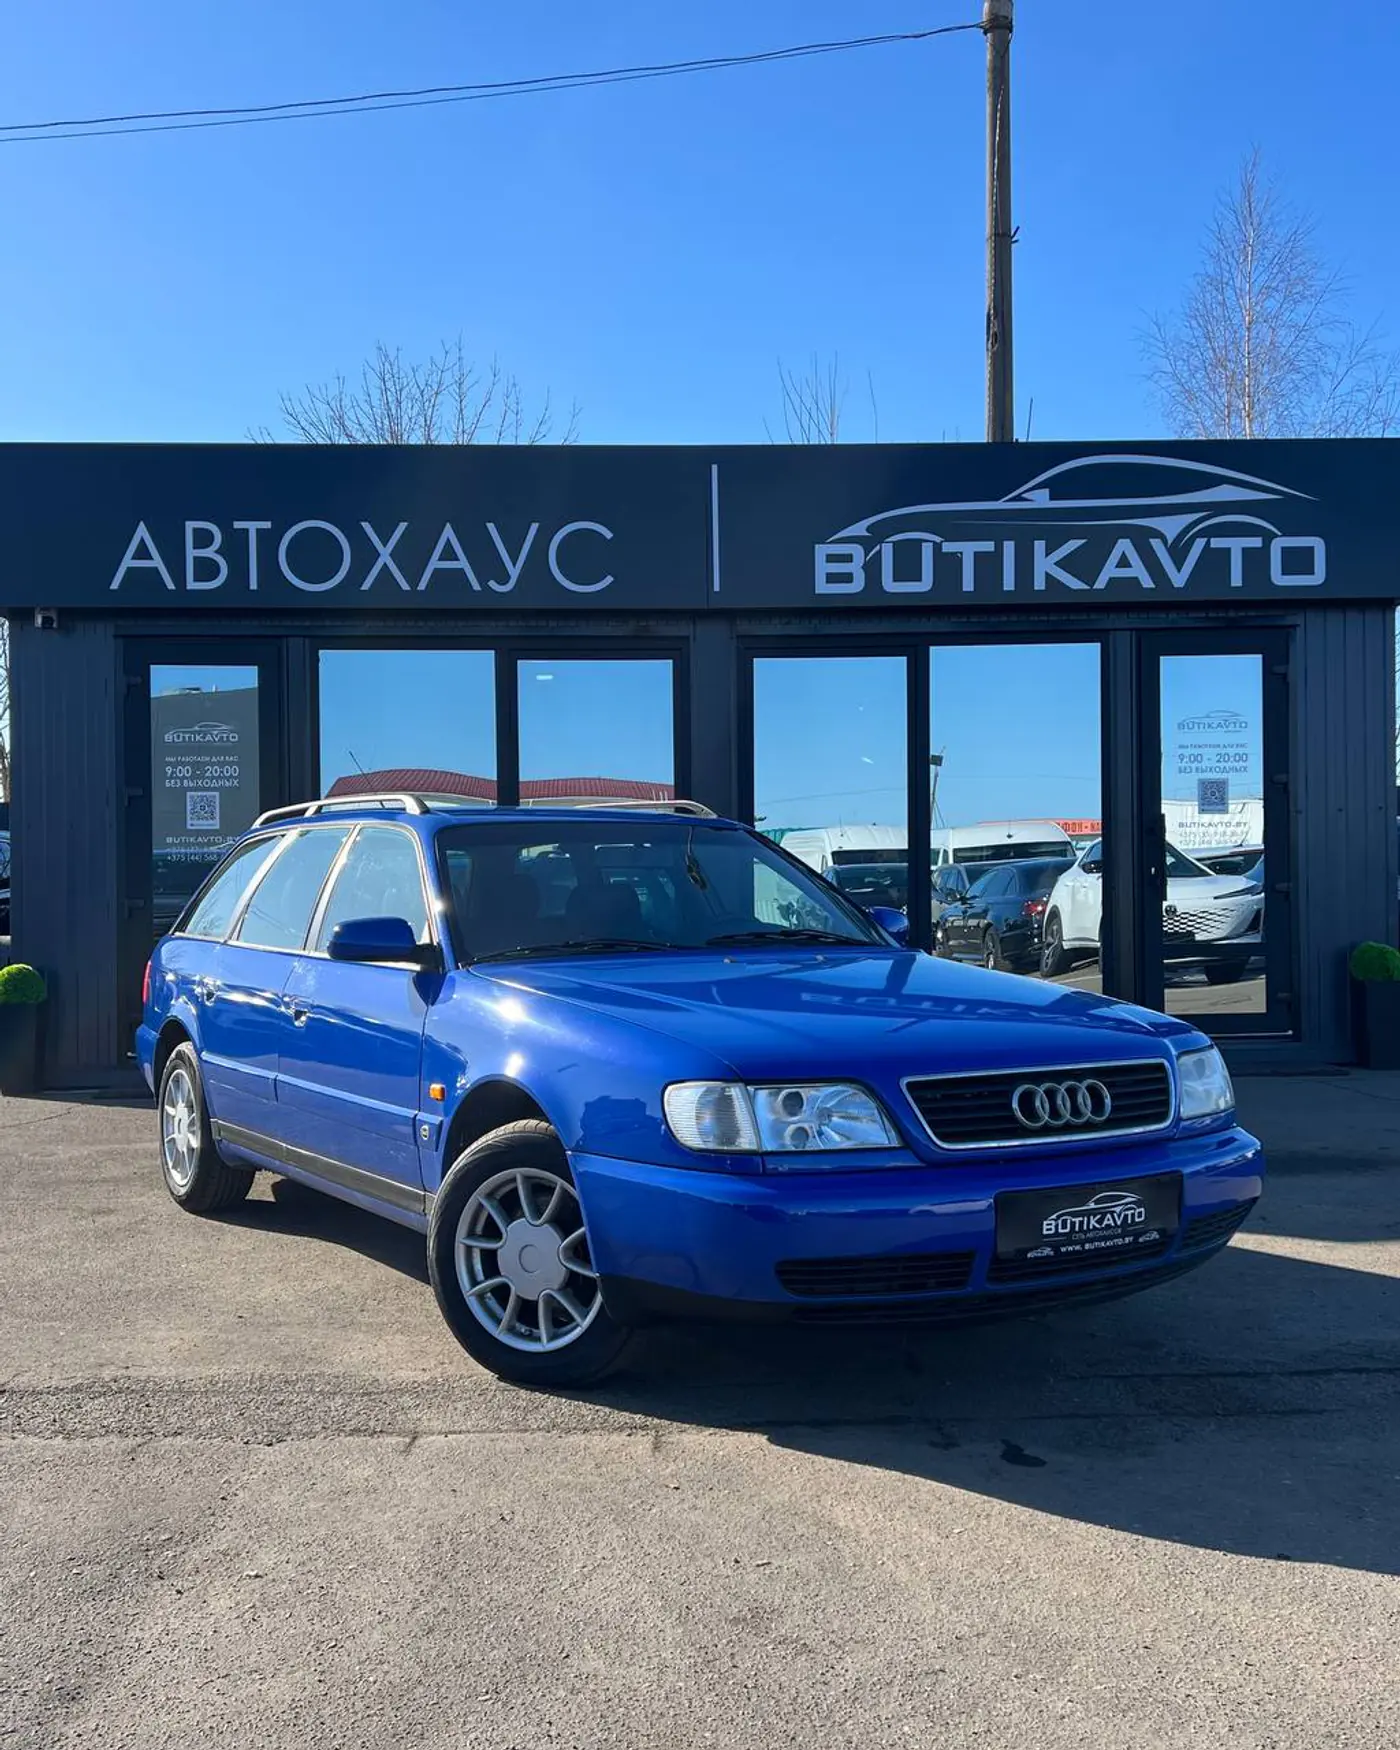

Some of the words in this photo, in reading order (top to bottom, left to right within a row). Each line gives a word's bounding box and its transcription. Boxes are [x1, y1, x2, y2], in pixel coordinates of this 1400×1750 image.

[109, 519, 615, 593] АВТОХАУС
[814, 535, 1326, 595] BUTIKAVTO
[1177, 720, 1249, 730] BUTIKAVTO
[164, 732, 239, 743] BUTIKAVTO
[1178, 753, 1203, 764] 9:00
[1215, 752, 1248, 763] 20:00
[165, 765, 192, 777] 9:00
[204, 765, 239, 777] 20:00
[1178, 766, 1193, 775] БЕЗ
[1195, 765, 1248, 775] ВЫХОДНЫХ
[165, 779, 181, 788] БЕЗ
[183, 779, 239, 788] ВЫХОДНЫХ
[1178, 821, 1248, 829] BUTIKAVTO.BY
[1042, 1207, 1146, 1235] BUTIKAVTO
